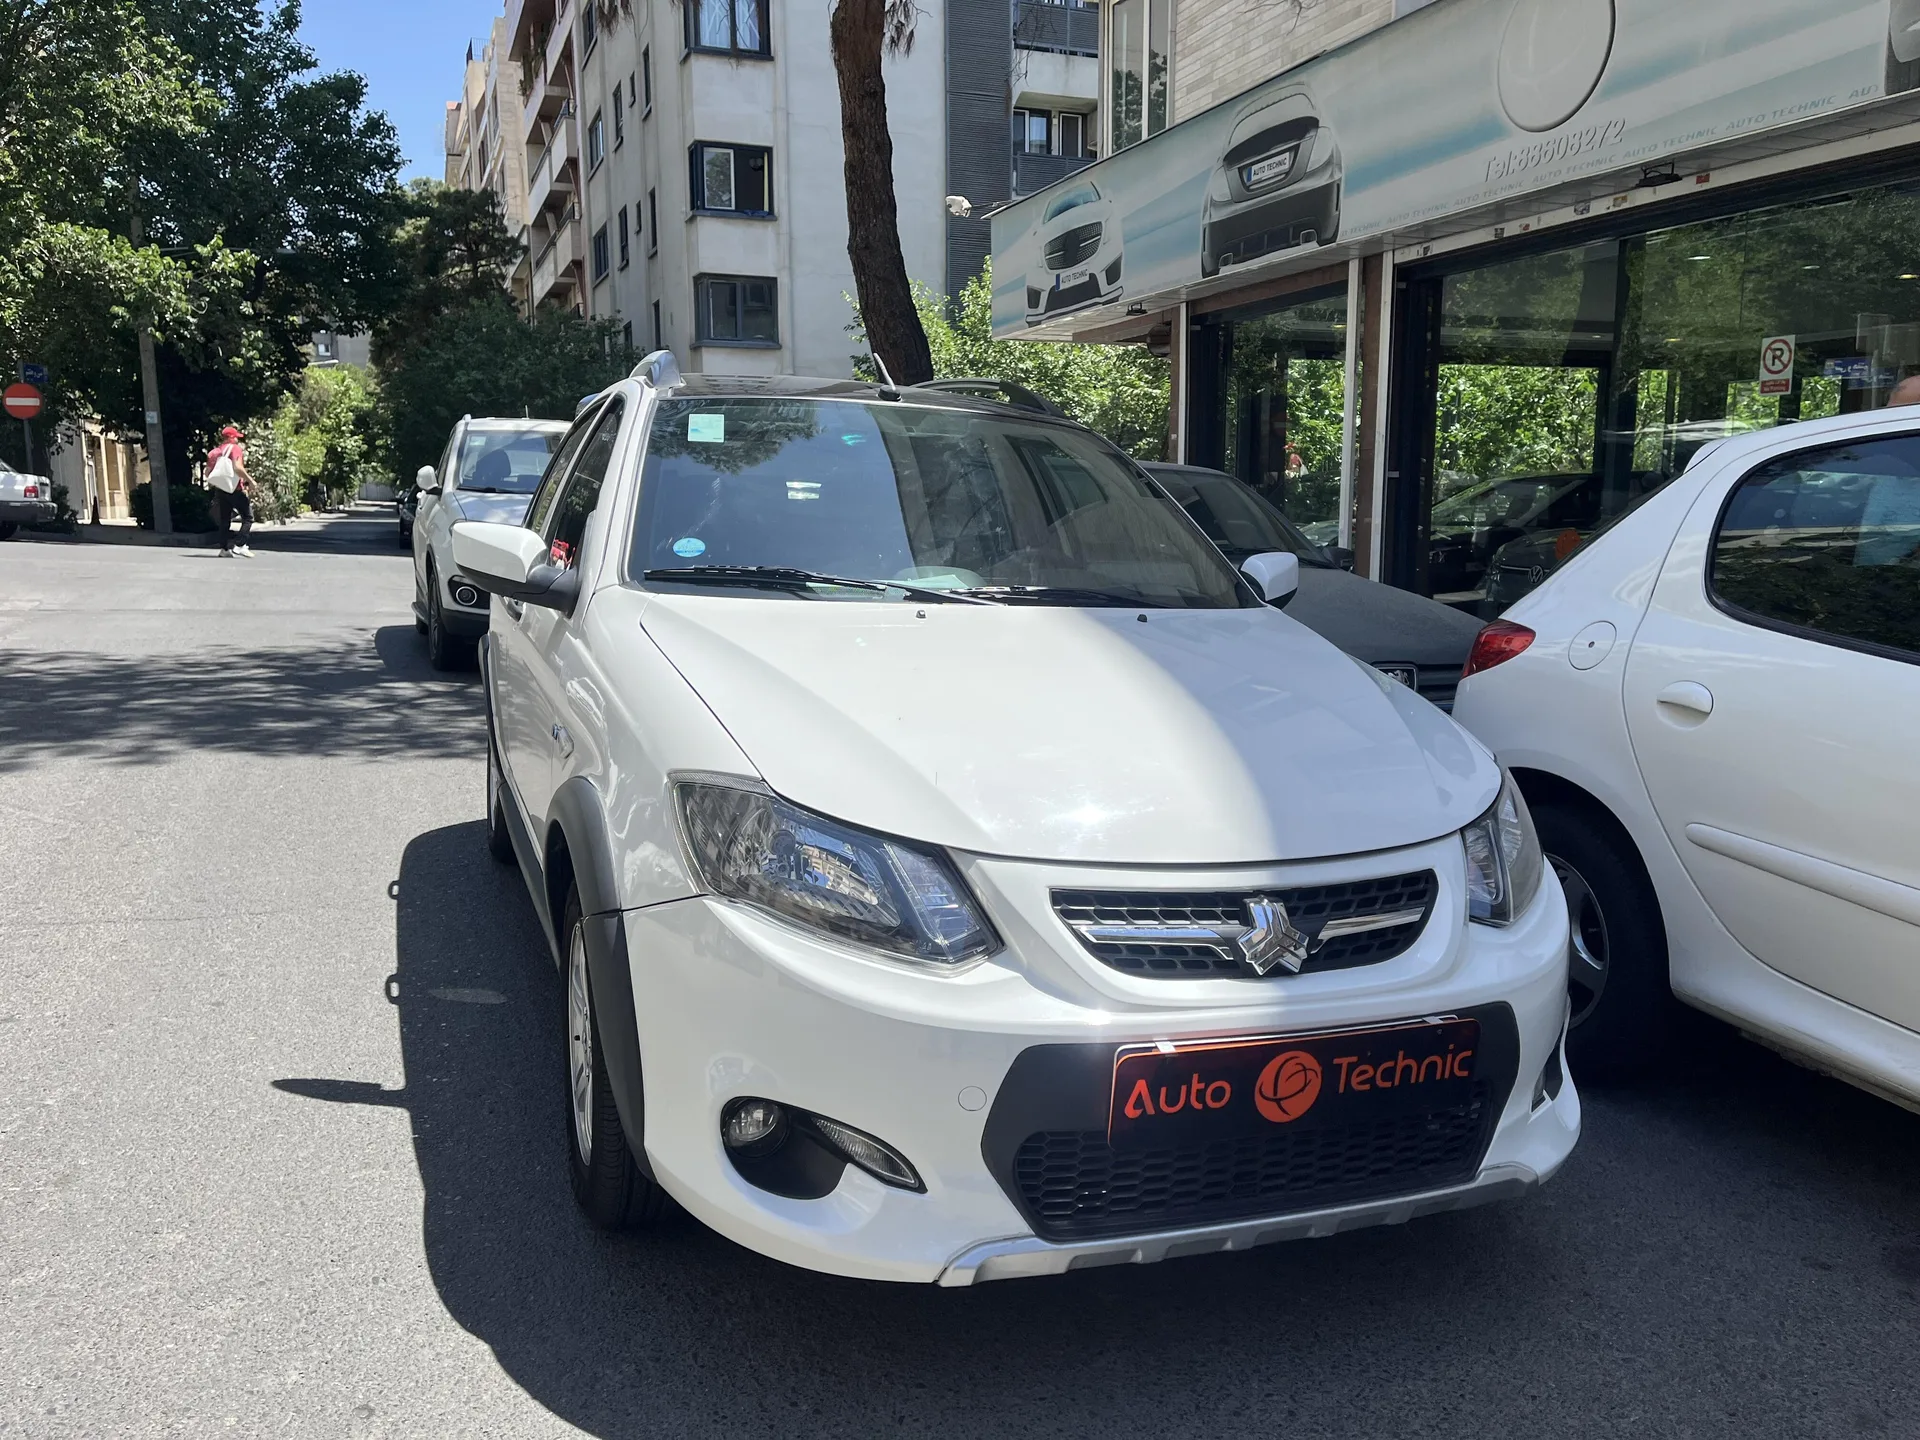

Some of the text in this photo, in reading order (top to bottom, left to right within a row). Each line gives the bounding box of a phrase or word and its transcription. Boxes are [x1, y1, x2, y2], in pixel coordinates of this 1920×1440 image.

[1253, 157, 1288, 176] AUTO TECHNIC
[1453, 193, 1480, 206] AUTO
[1483, 180, 1525, 198] TECHNIC
[1531, 169, 1562, 184] AUTO
[1566, 154, 1617, 173] TECHNIC
[1622, 143, 1659, 159] AUTO
[1662, 126, 1717, 149] TECHNIC
[1725, 113, 1767, 131] AUTO
[1771, 94, 1837, 119] TECHNIC
[1061, 268, 1088, 284] AUTO TECHNIC
[1123, 1043, 1473, 1120] Auto Technic
